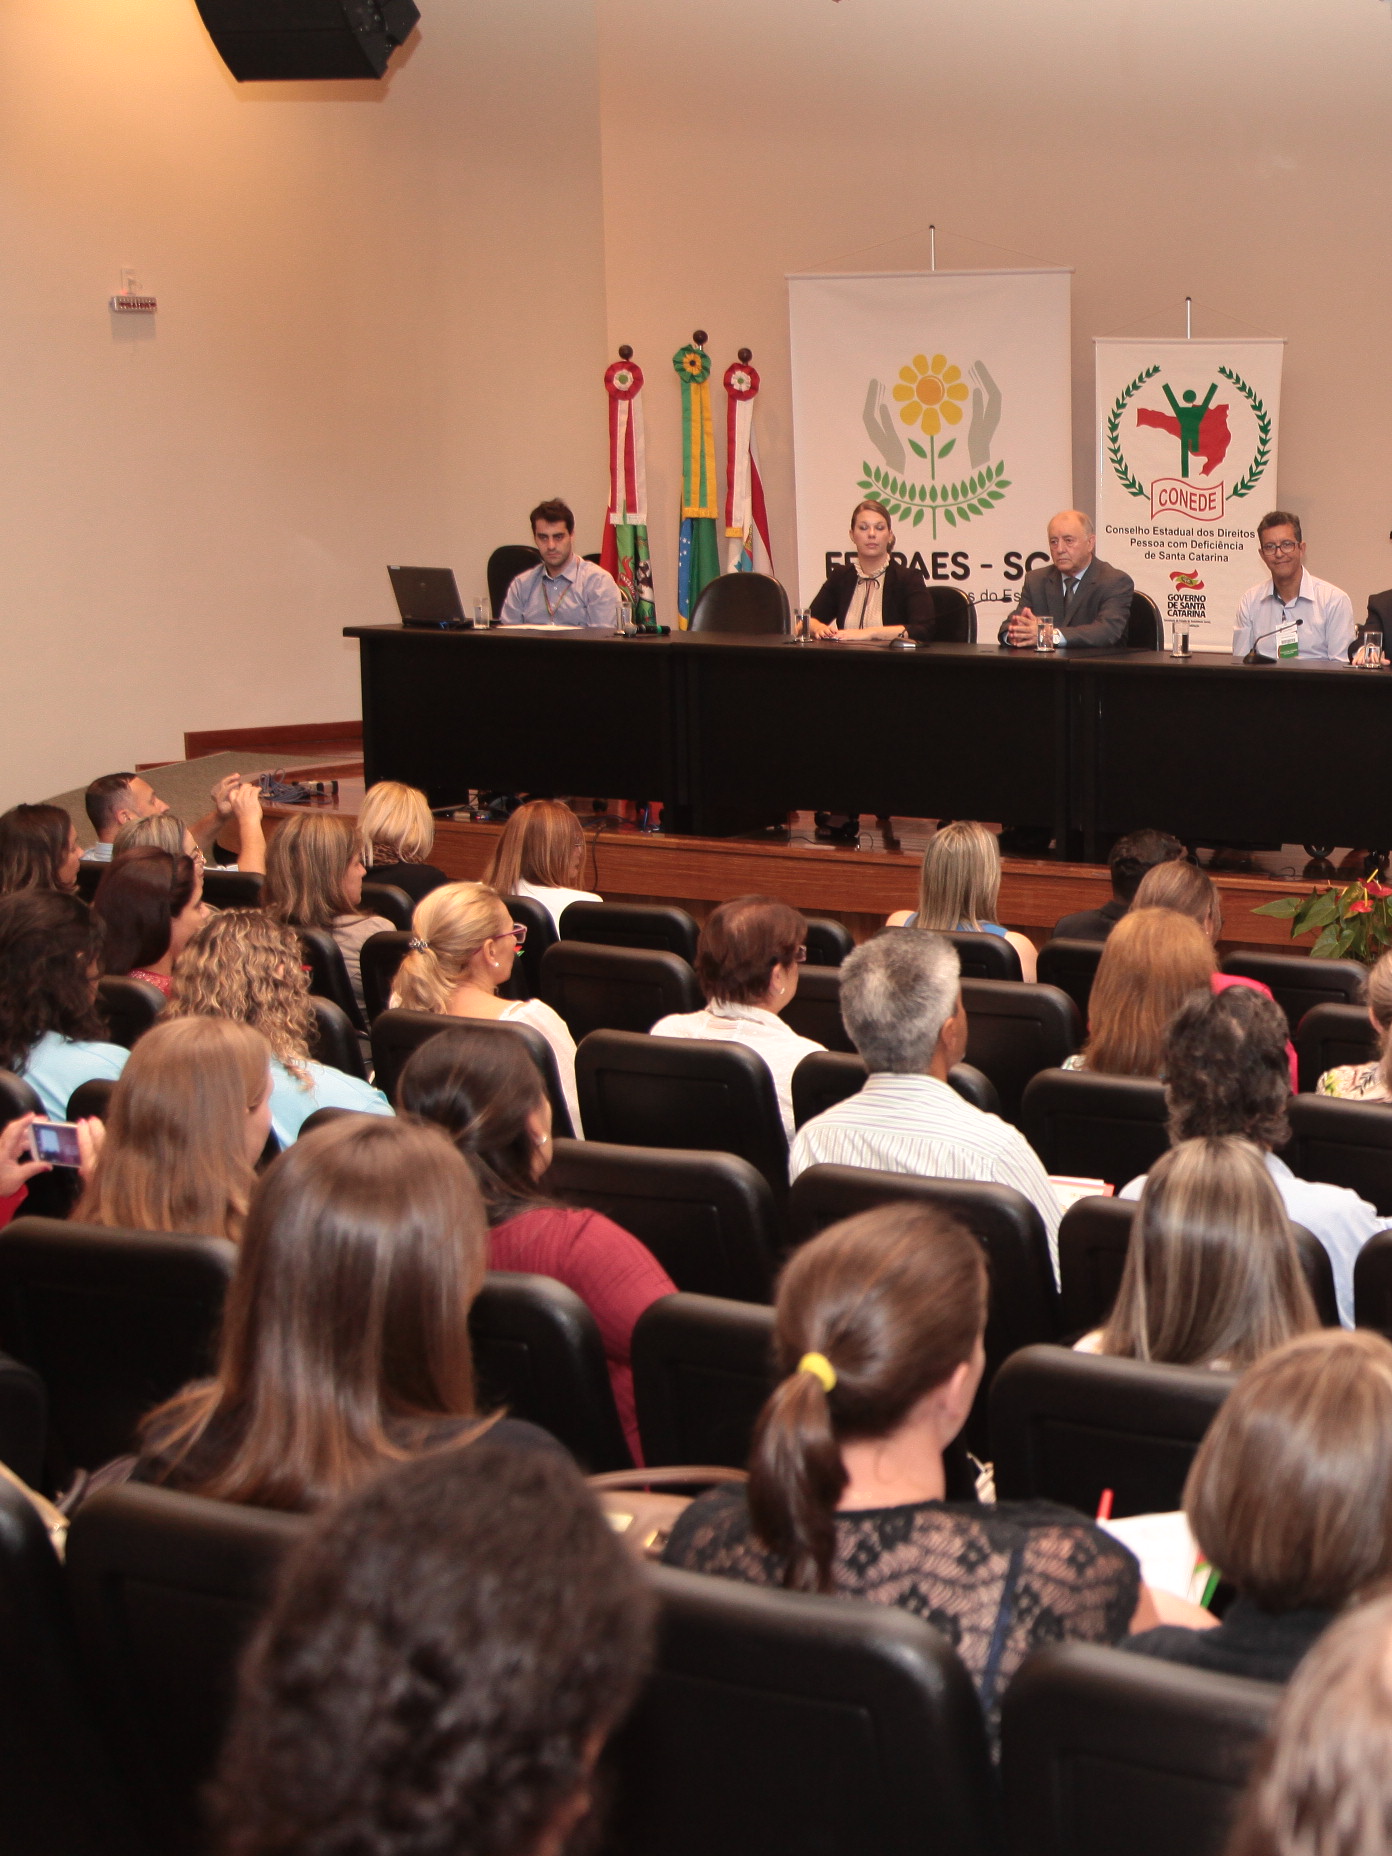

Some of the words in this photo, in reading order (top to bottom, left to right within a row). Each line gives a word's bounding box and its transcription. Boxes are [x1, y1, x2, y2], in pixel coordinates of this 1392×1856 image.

[1158, 487, 1217, 512] CONEDE
[1105, 525, 1150, 535] Conselho
[1152, 526, 1194, 537] Estadual
[1197, 527, 1214, 537] dos
[1217, 528, 1255, 538] Direitos
[1130, 538, 1165, 548] Pessoa
[1167, 541, 1188, 549] com
[1190, 539, 1244, 550] Deficiência
[1144, 551, 1156, 560] de
[1158, 551, 1186, 561] Santa
[1188, 552, 1229, 562] Catarina
[1167, 594, 1207, 603] GOVERNO
[1180, 602, 1206, 610] SANTA
[1167, 609, 1206, 618] CATARINA
